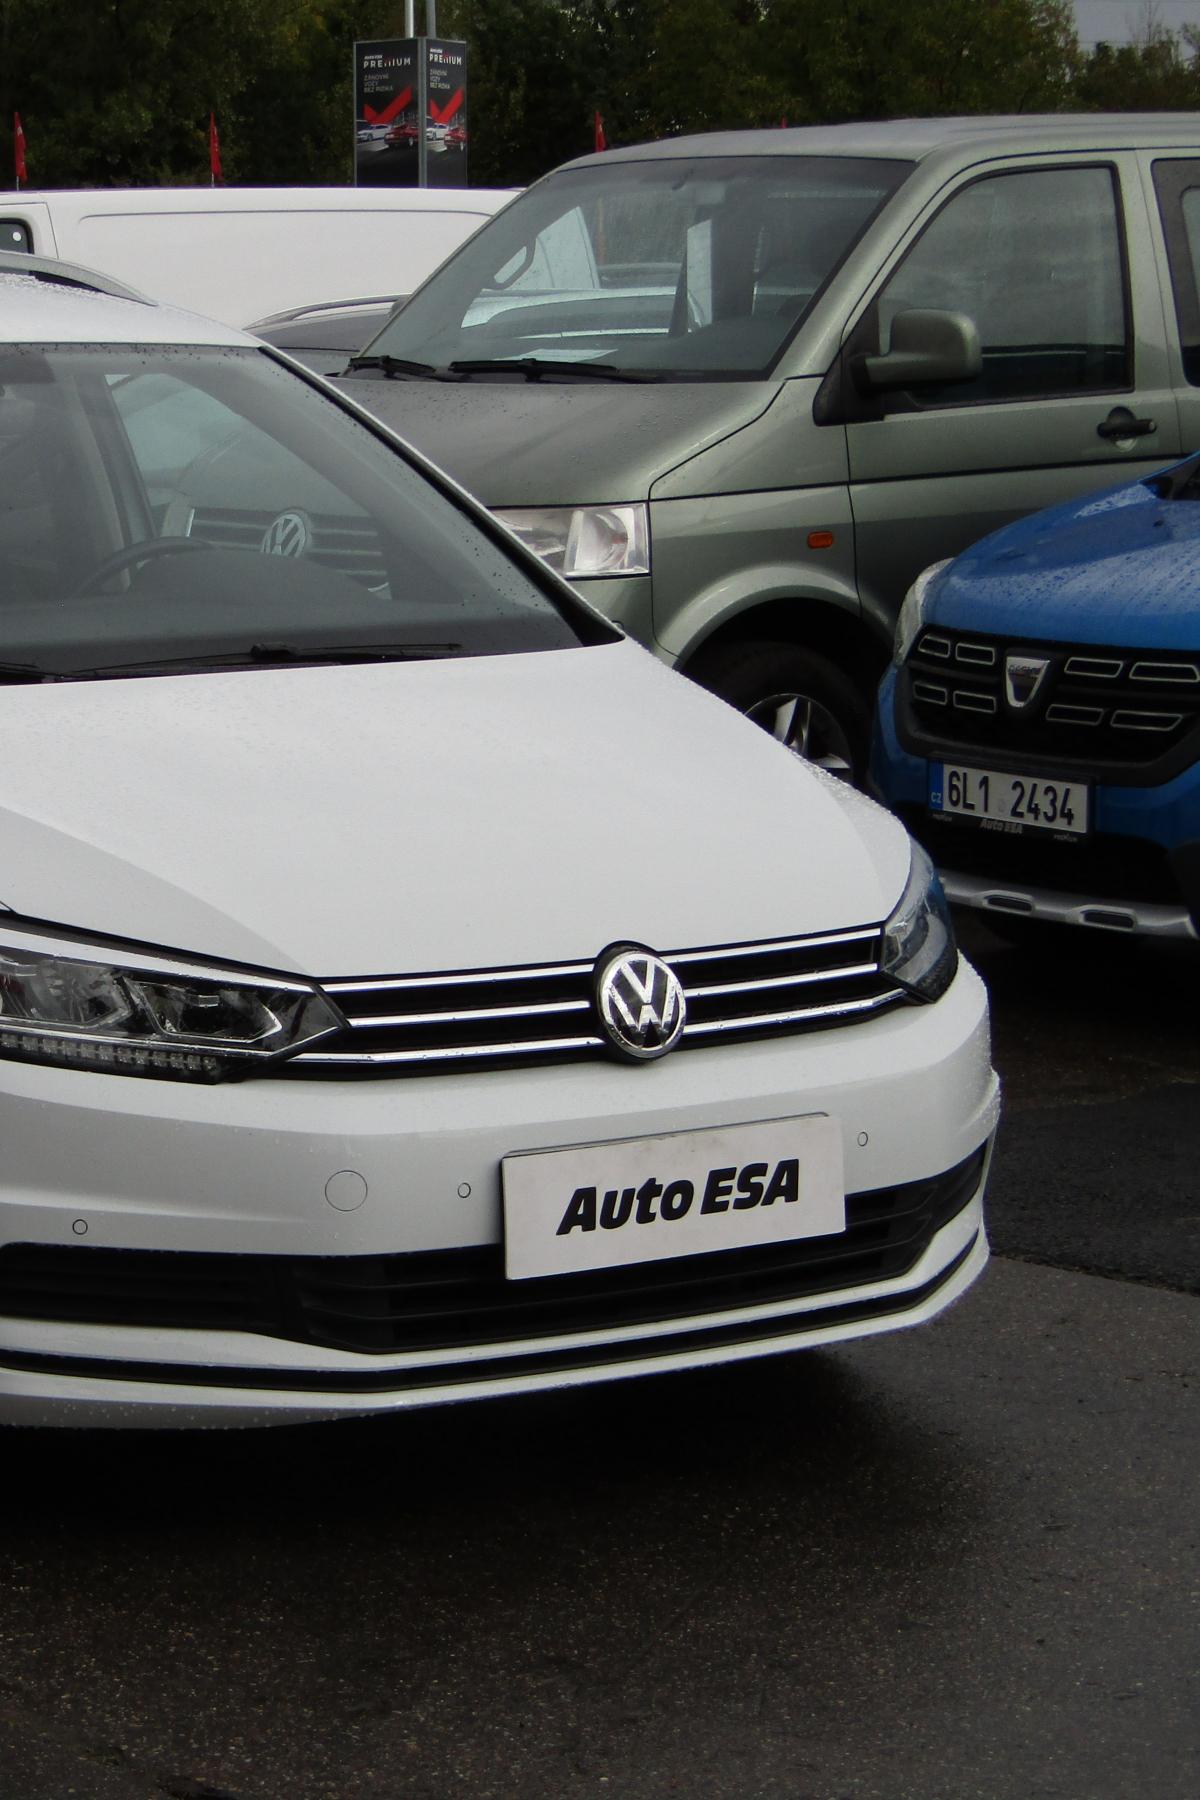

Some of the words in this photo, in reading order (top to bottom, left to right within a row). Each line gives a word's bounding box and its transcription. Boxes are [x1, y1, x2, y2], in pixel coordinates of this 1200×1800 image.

[363, 56, 411, 69] PREMIUM
[930, 791, 943, 804] CZ
[947, 770, 990, 813] 6L1
[1010, 780, 1075, 826] 2434
[980, 818, 1004, 832] Auto
[555, 1177, 695, 1236] Auto
[699, 1158, 800, 1215] ESA
